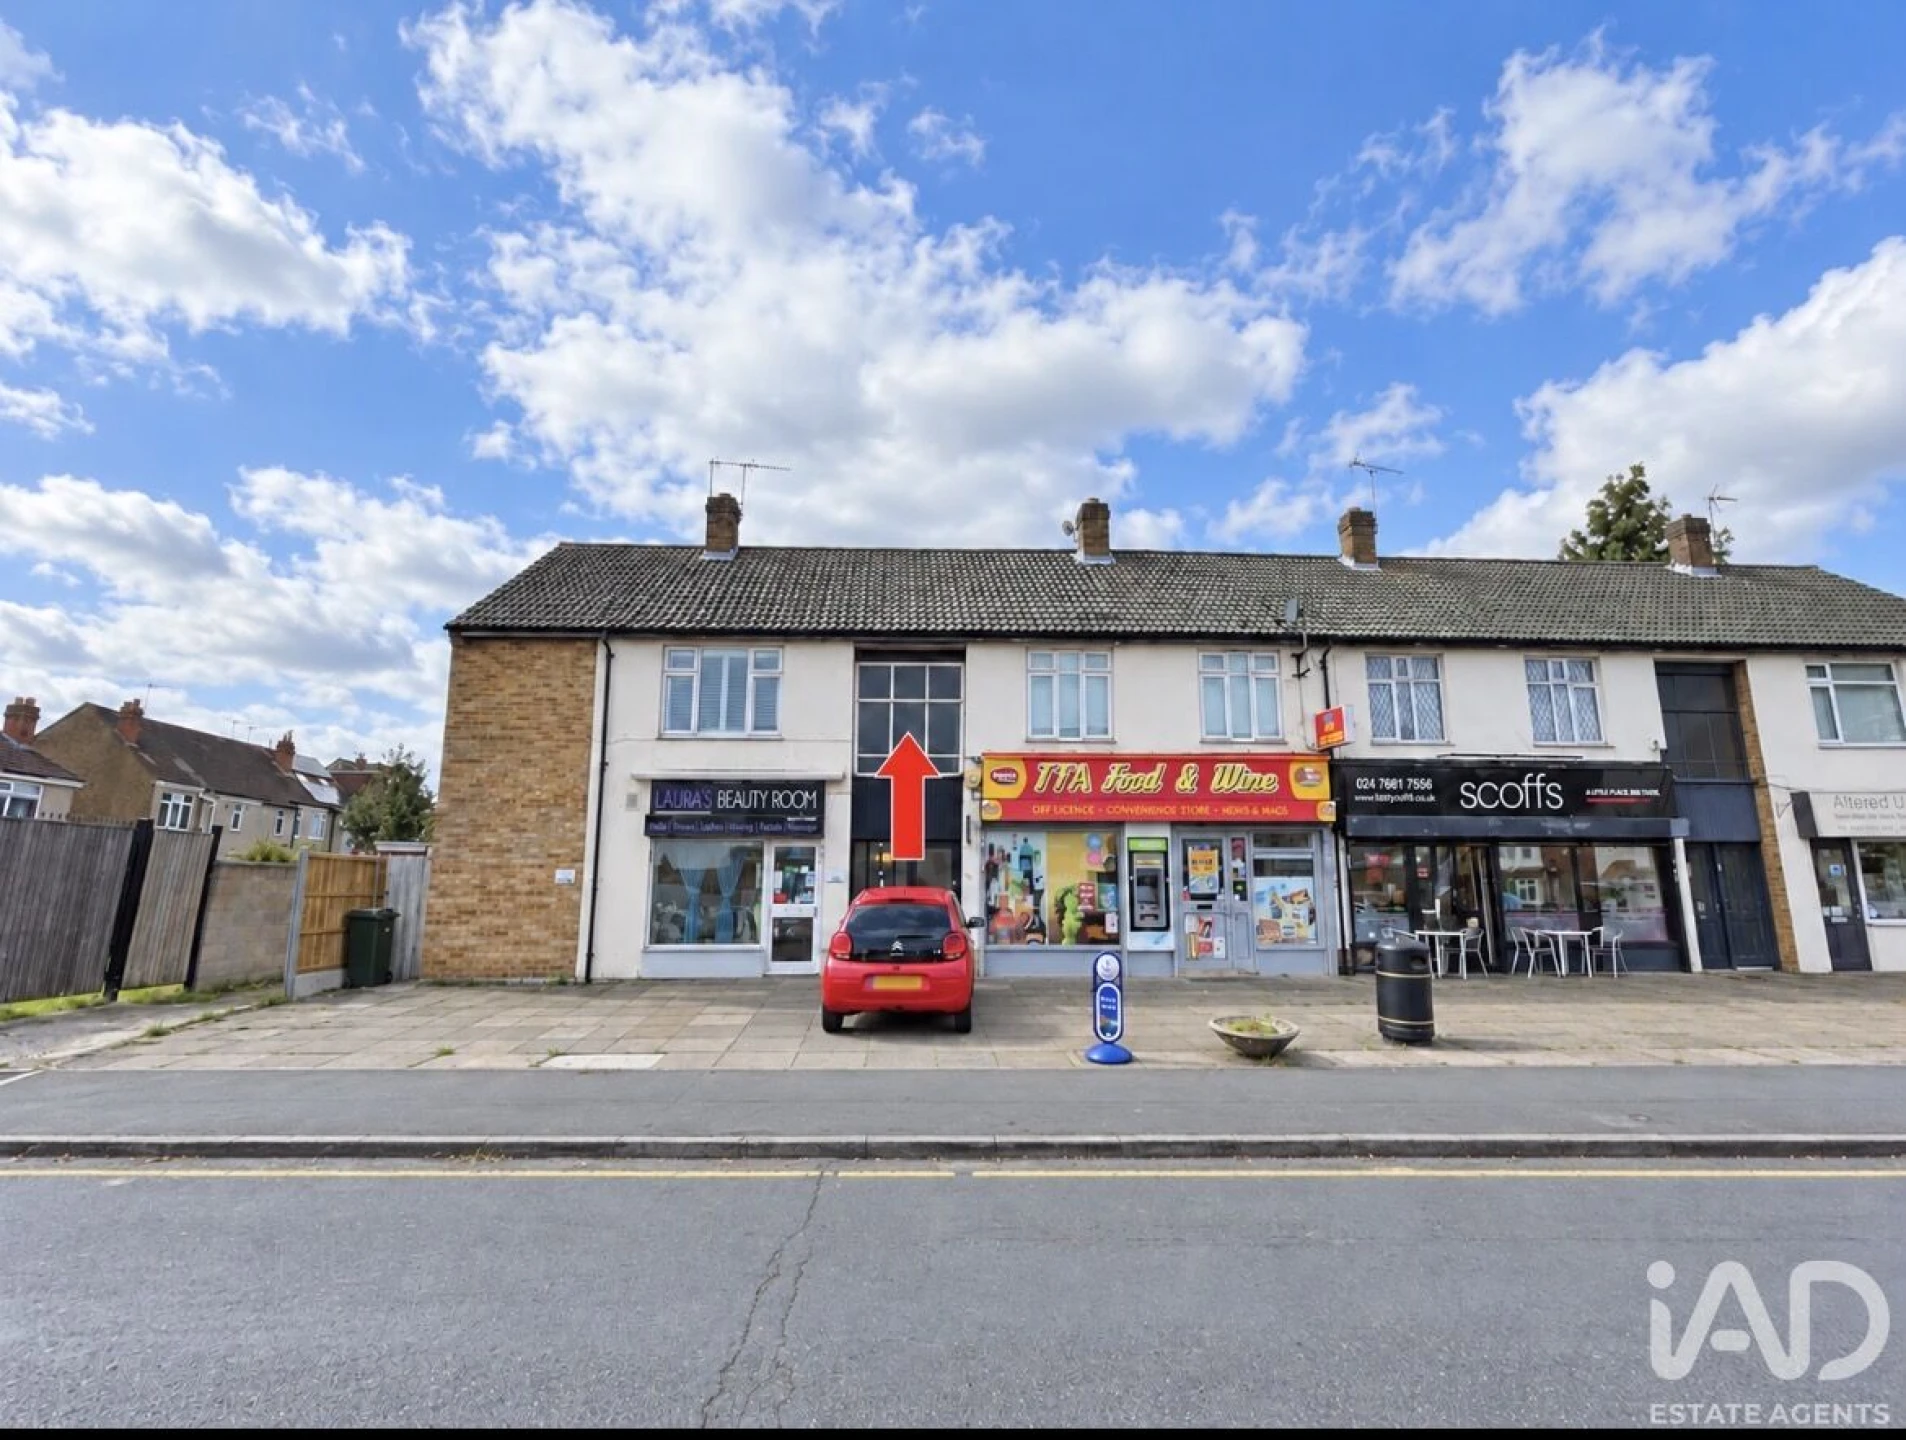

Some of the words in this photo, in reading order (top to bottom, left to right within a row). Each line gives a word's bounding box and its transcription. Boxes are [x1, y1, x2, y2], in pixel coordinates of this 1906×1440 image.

[1101, 762, 1167, 793] Food
[1175, 763, 1199, 793] &
[1210, 763, 1279, 793] Wine
[1356, 777, 1375, 790] 024
[655, 789, 712, 809] LAURA'S
[717, 789, 769, 809] BEAUTY
[771, 789, 817, 809] ROOM
[1460, 772, 1564, 809] scoffs
[1032, 805, 1050, 815] OFF
[1834, 794, 1889, 809] Altered
